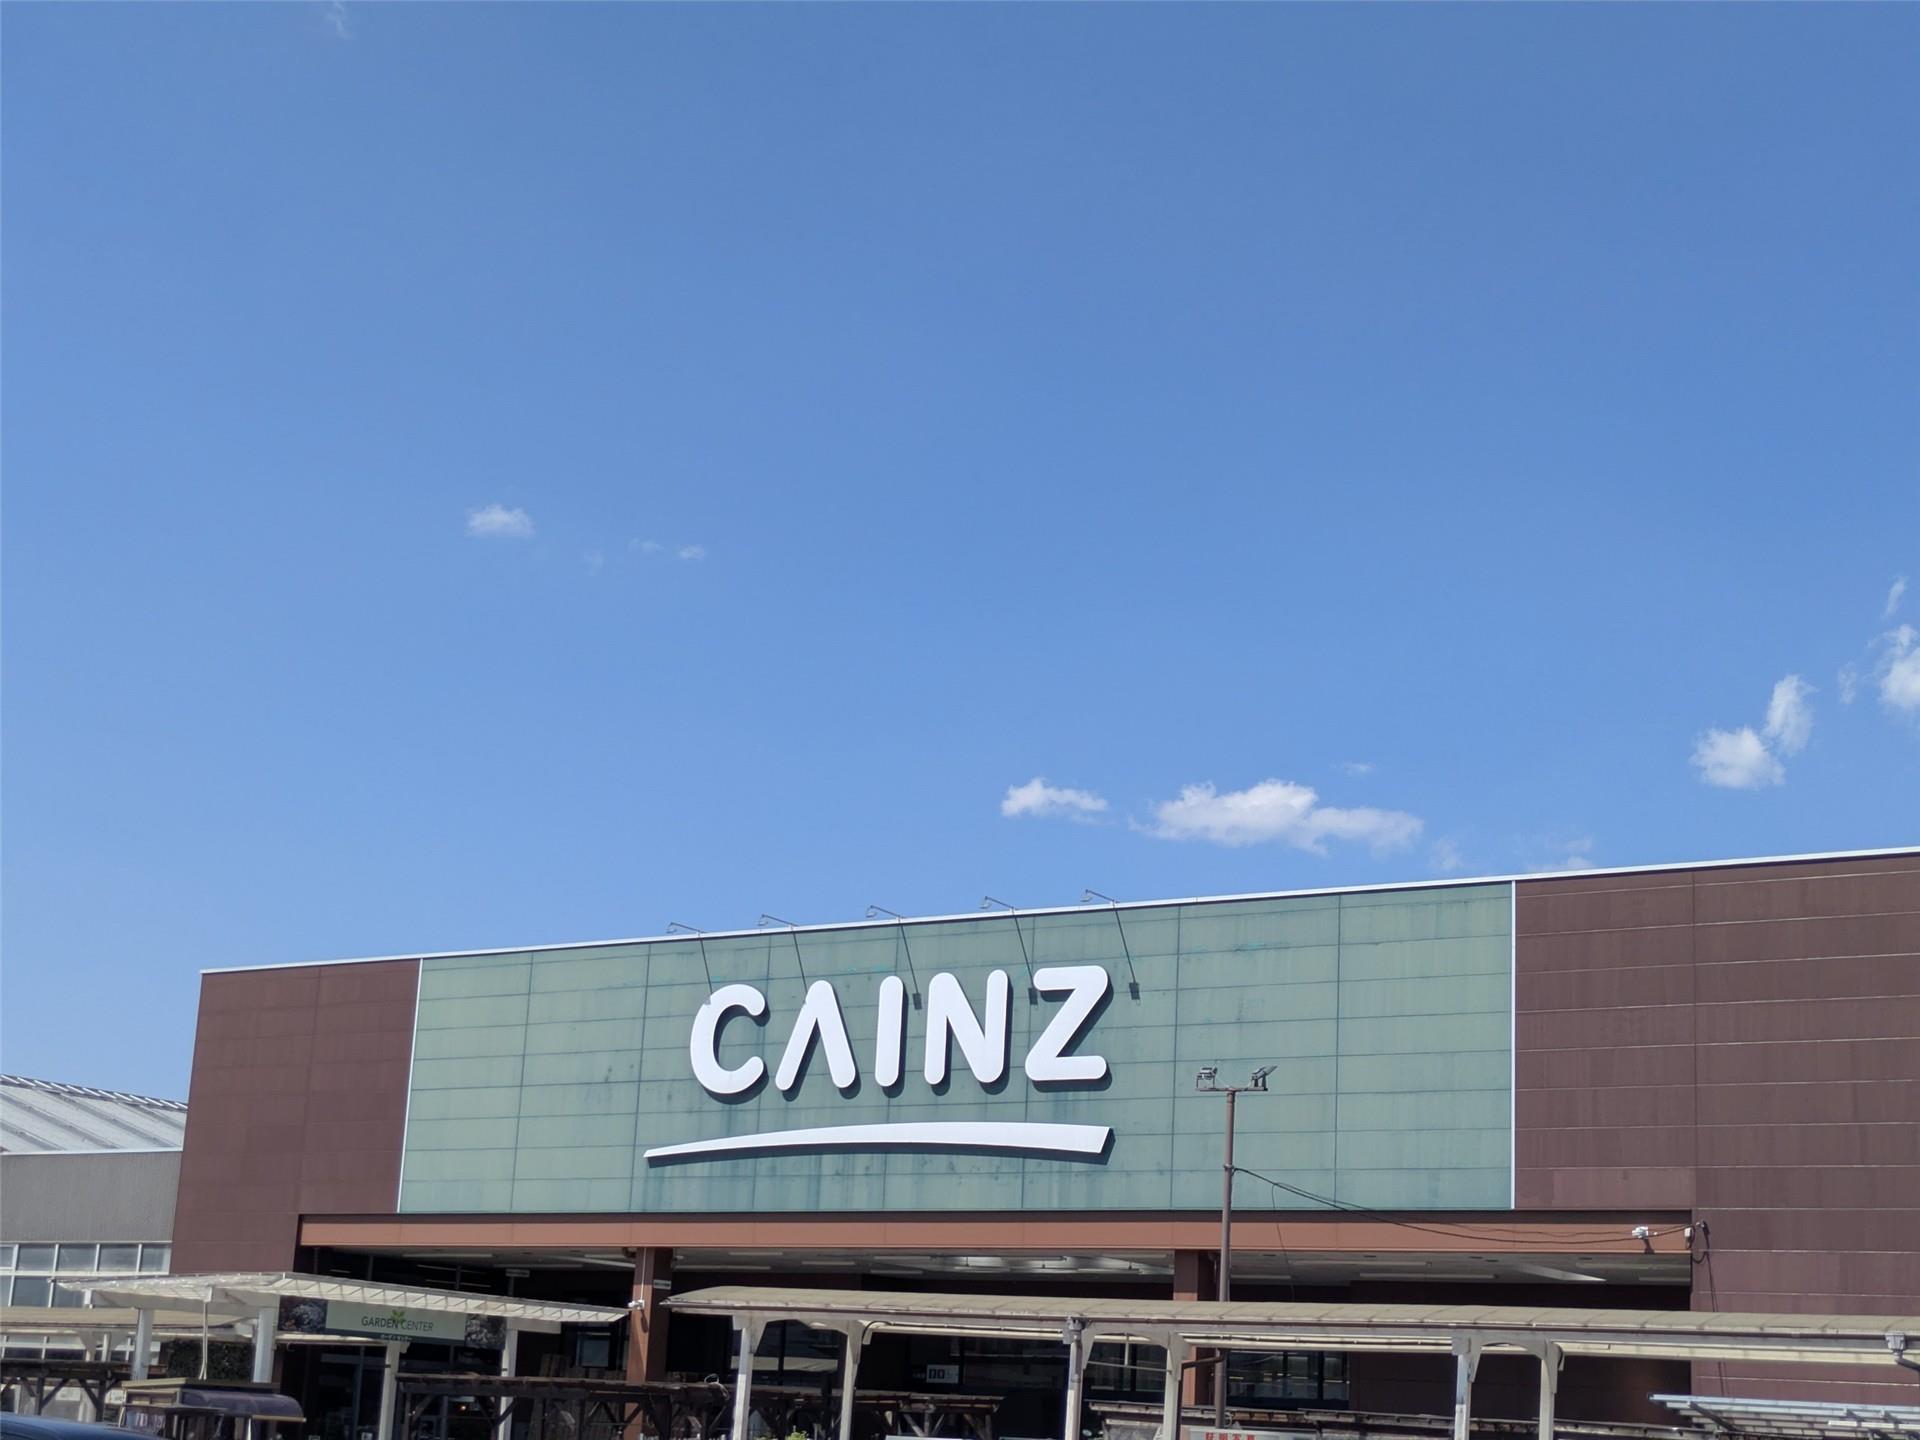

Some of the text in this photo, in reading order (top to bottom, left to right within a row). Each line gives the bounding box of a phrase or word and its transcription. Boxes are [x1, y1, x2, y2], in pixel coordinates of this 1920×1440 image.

[689, 965, 1109, 1095] CAINZ
[361, 1316, 434, 1332] GARDEN CENTER
